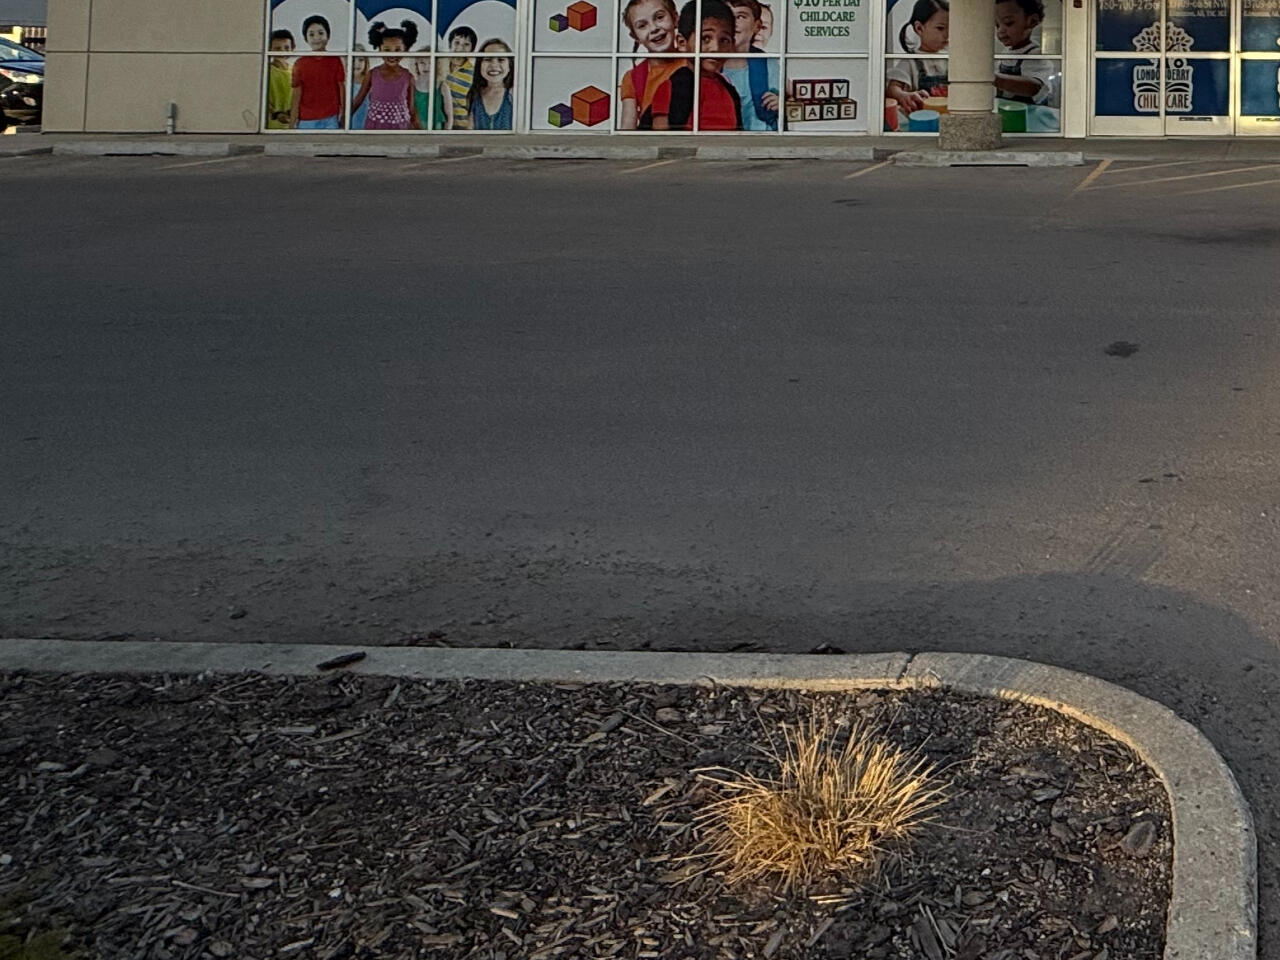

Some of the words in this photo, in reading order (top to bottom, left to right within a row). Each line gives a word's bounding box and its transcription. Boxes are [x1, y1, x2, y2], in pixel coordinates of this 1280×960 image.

[799, 11, 856, 22] CHILDCARE
[804, 26, 850, 37] SERVICES
[1136, 69, 1190, 81] LONDODERRY
[799, 85, 845, 97] DAY
[1137, 93, 1190, 109] CHILCARE
[788, 105, 852, 120] CARE
